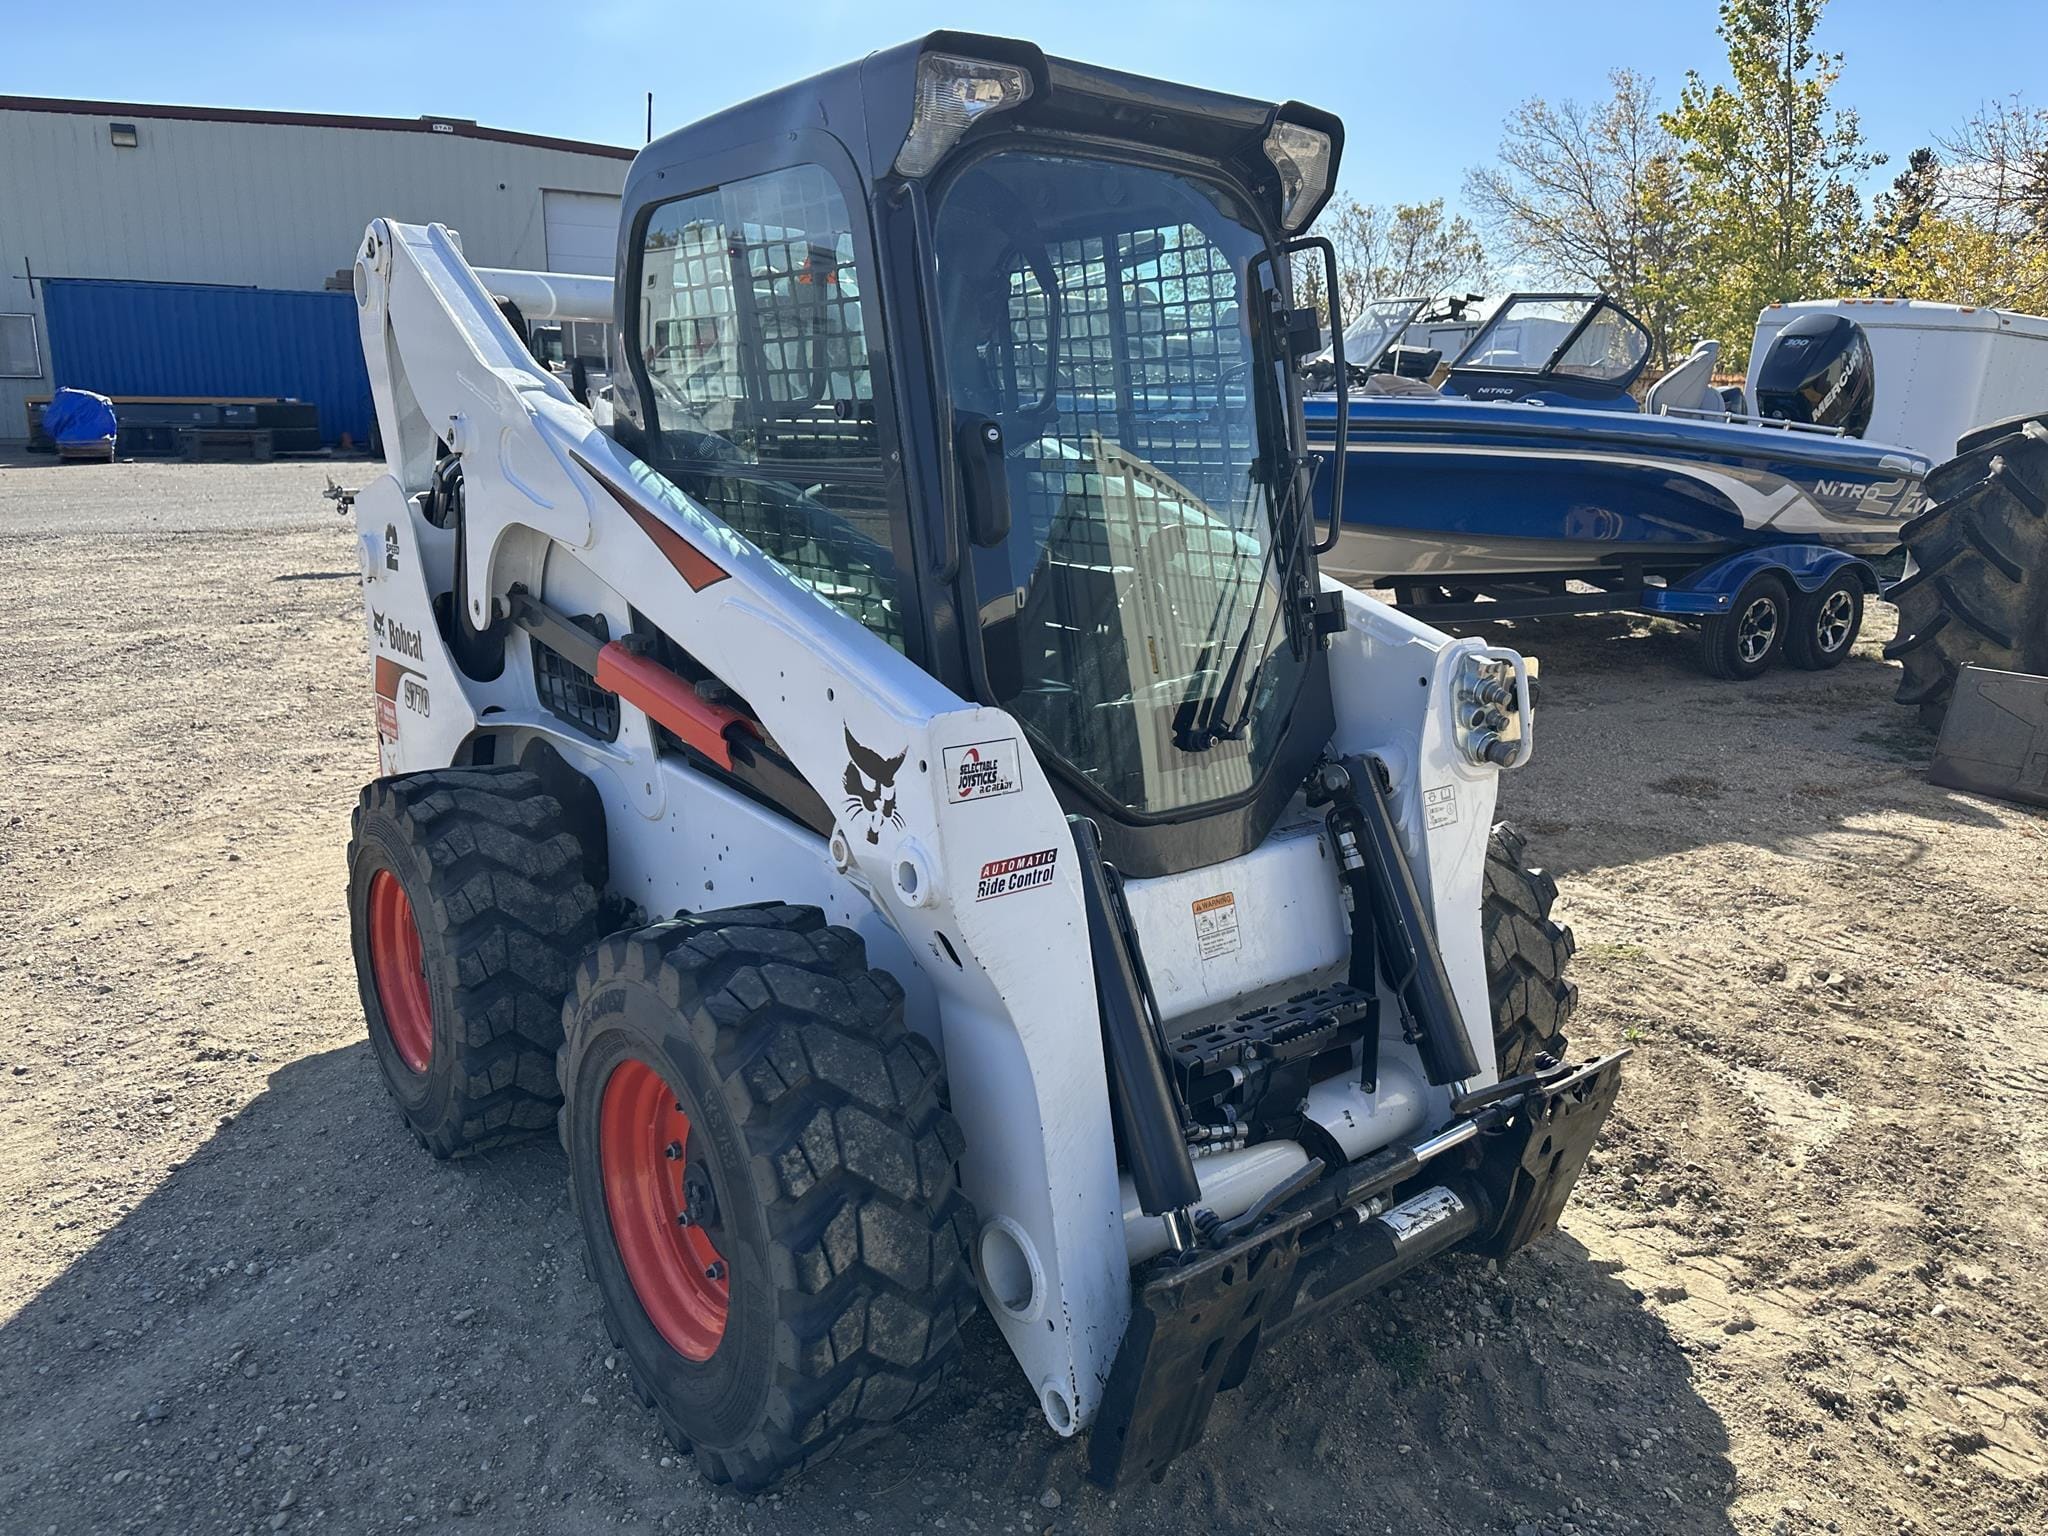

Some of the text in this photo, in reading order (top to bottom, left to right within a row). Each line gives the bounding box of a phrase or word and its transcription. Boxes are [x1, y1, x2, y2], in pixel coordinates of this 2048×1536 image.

[388, 618, 424, 662] Bobcat
[404, 679, 431, 718] S770
[958, 771, 998, 789] JOYSTICKS
[960, 759, 998, 775] SELECTABLE
[983, 851, 1055, 877] AUTOMATIC
[977, 864, 1055, 898] Ride Control
[1202, 895, 1232, 909] WARNING
